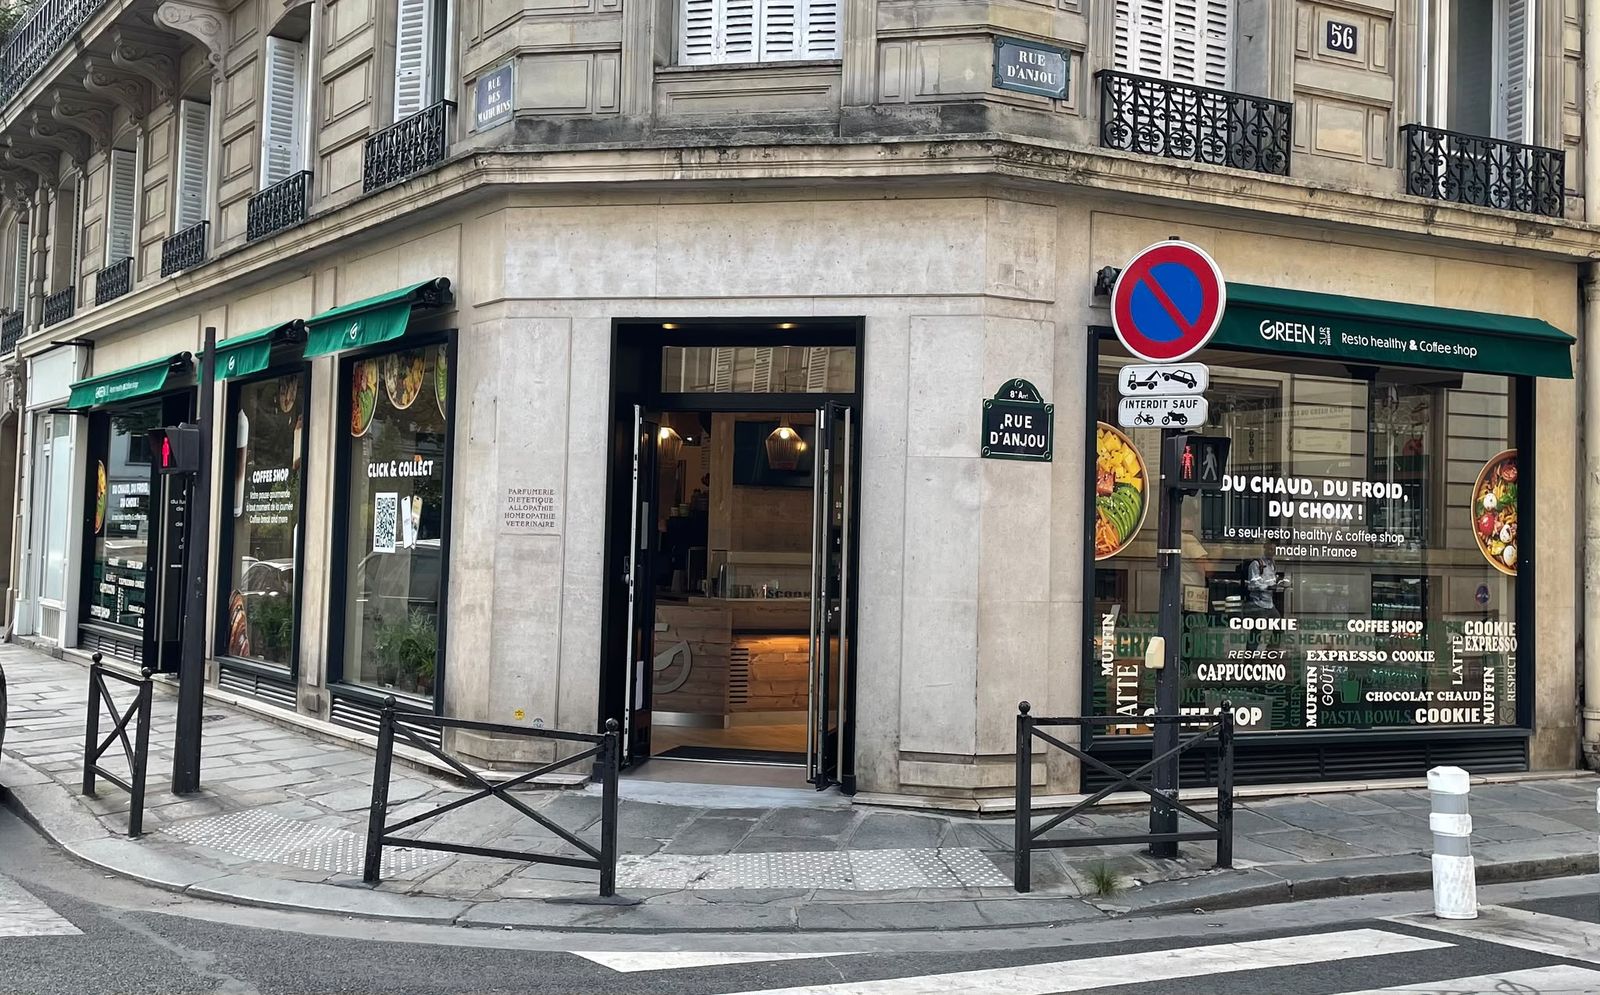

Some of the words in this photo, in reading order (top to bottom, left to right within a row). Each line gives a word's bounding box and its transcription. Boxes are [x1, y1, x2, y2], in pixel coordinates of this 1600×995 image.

[1331, 23, 1353, 50] 56
[1019, 50, 1046, 66] RUE
[1007, 65, 1056, 84] D'ANJOU
[488, 76, 501, 92] RUE
[488, 90, 501, 104] DES
[1260, 320, 1315, 344] GREEN
[1342, 332, 1369, 346] Resto
[1370, 336, 1407, 352] healthy
[1409, 340, 1418, 350] &
[1420, 340, 1452, 354] Coffee
[1453, 344, 1478, 358] shop
[1126, 400, 1168, 408] INTERDIT
[1172, 400, 1198, 408] SAUF
[1004, 414, 1032, 428] RUE
[990, 432, 1045, 448] D'ANJOU
[252, 470, 272, 484] COFFEE
[272, 468, 289, 482] SHOP
[368, 463, 389, 478] CLICK
[390, 460, 397, 477] &
[398, 460, 434, 477] COLLECT
[1220, 475, 1246, 492] DU
[1250, 476, 1318, 498] CHAUD,
[1323, 480, 1348, 496] DU
[1352, 481, 1408, 502] FROID,
[508, 496, 554, 505] DIETETIQUE
[1268, 500, 1294, 518] DU
[1298, 502, 1352, 520] CHOIX
[1358, 504, 1362, 520] !
[1224, 526, 1236, 537] Le
[1238, 526, 1260, 538] seul
[1264, 528, 1290, 540] resto
[1294, 528, 1332, 544] healthy
[1336, 530, 1343, 541] &
[1346, 530, 1377, 542] coffee
[1379, 532, 1404, 546] shop
[1276, 546, 1306, 556] made
[1310, 545, 1319, 556] in
[1322, 546, 1357, 558] France
[1230, 618, 1297, 630] COOKIE
[1347, 620, 1390, 633] COFFEE
[1391, 620, 1424, 634] SHOP
[1464, 620, 1516, 636] COOKIE
[1102, 614, 1114, 676] MUFFIN
[1464, 636, 1518, 652] EXPRESSO
[1228, 650, 1286, 660] RESPECT
[1306, 650, 1388, 662] EXPRESSO
[1392, 651, 1436, 662] COOKIE
[1452, 635, 1464, 686] LATTE
[1198, 664, 1286, 681] CAPPUCCINO
[1507, 655, 1516, 702] RESPECT
[1306, 666, 1318, 728] MUFFIN
[1366, 692, 1434, 702] CHOCOLAT
[1436, 692, 1482, 701] CHAUD
[1483, 667, 1494, 724] MUFFIN
[1320, 710, 1362, 725] PASTA
[1416, 708, 1480, 724] COOKIE
